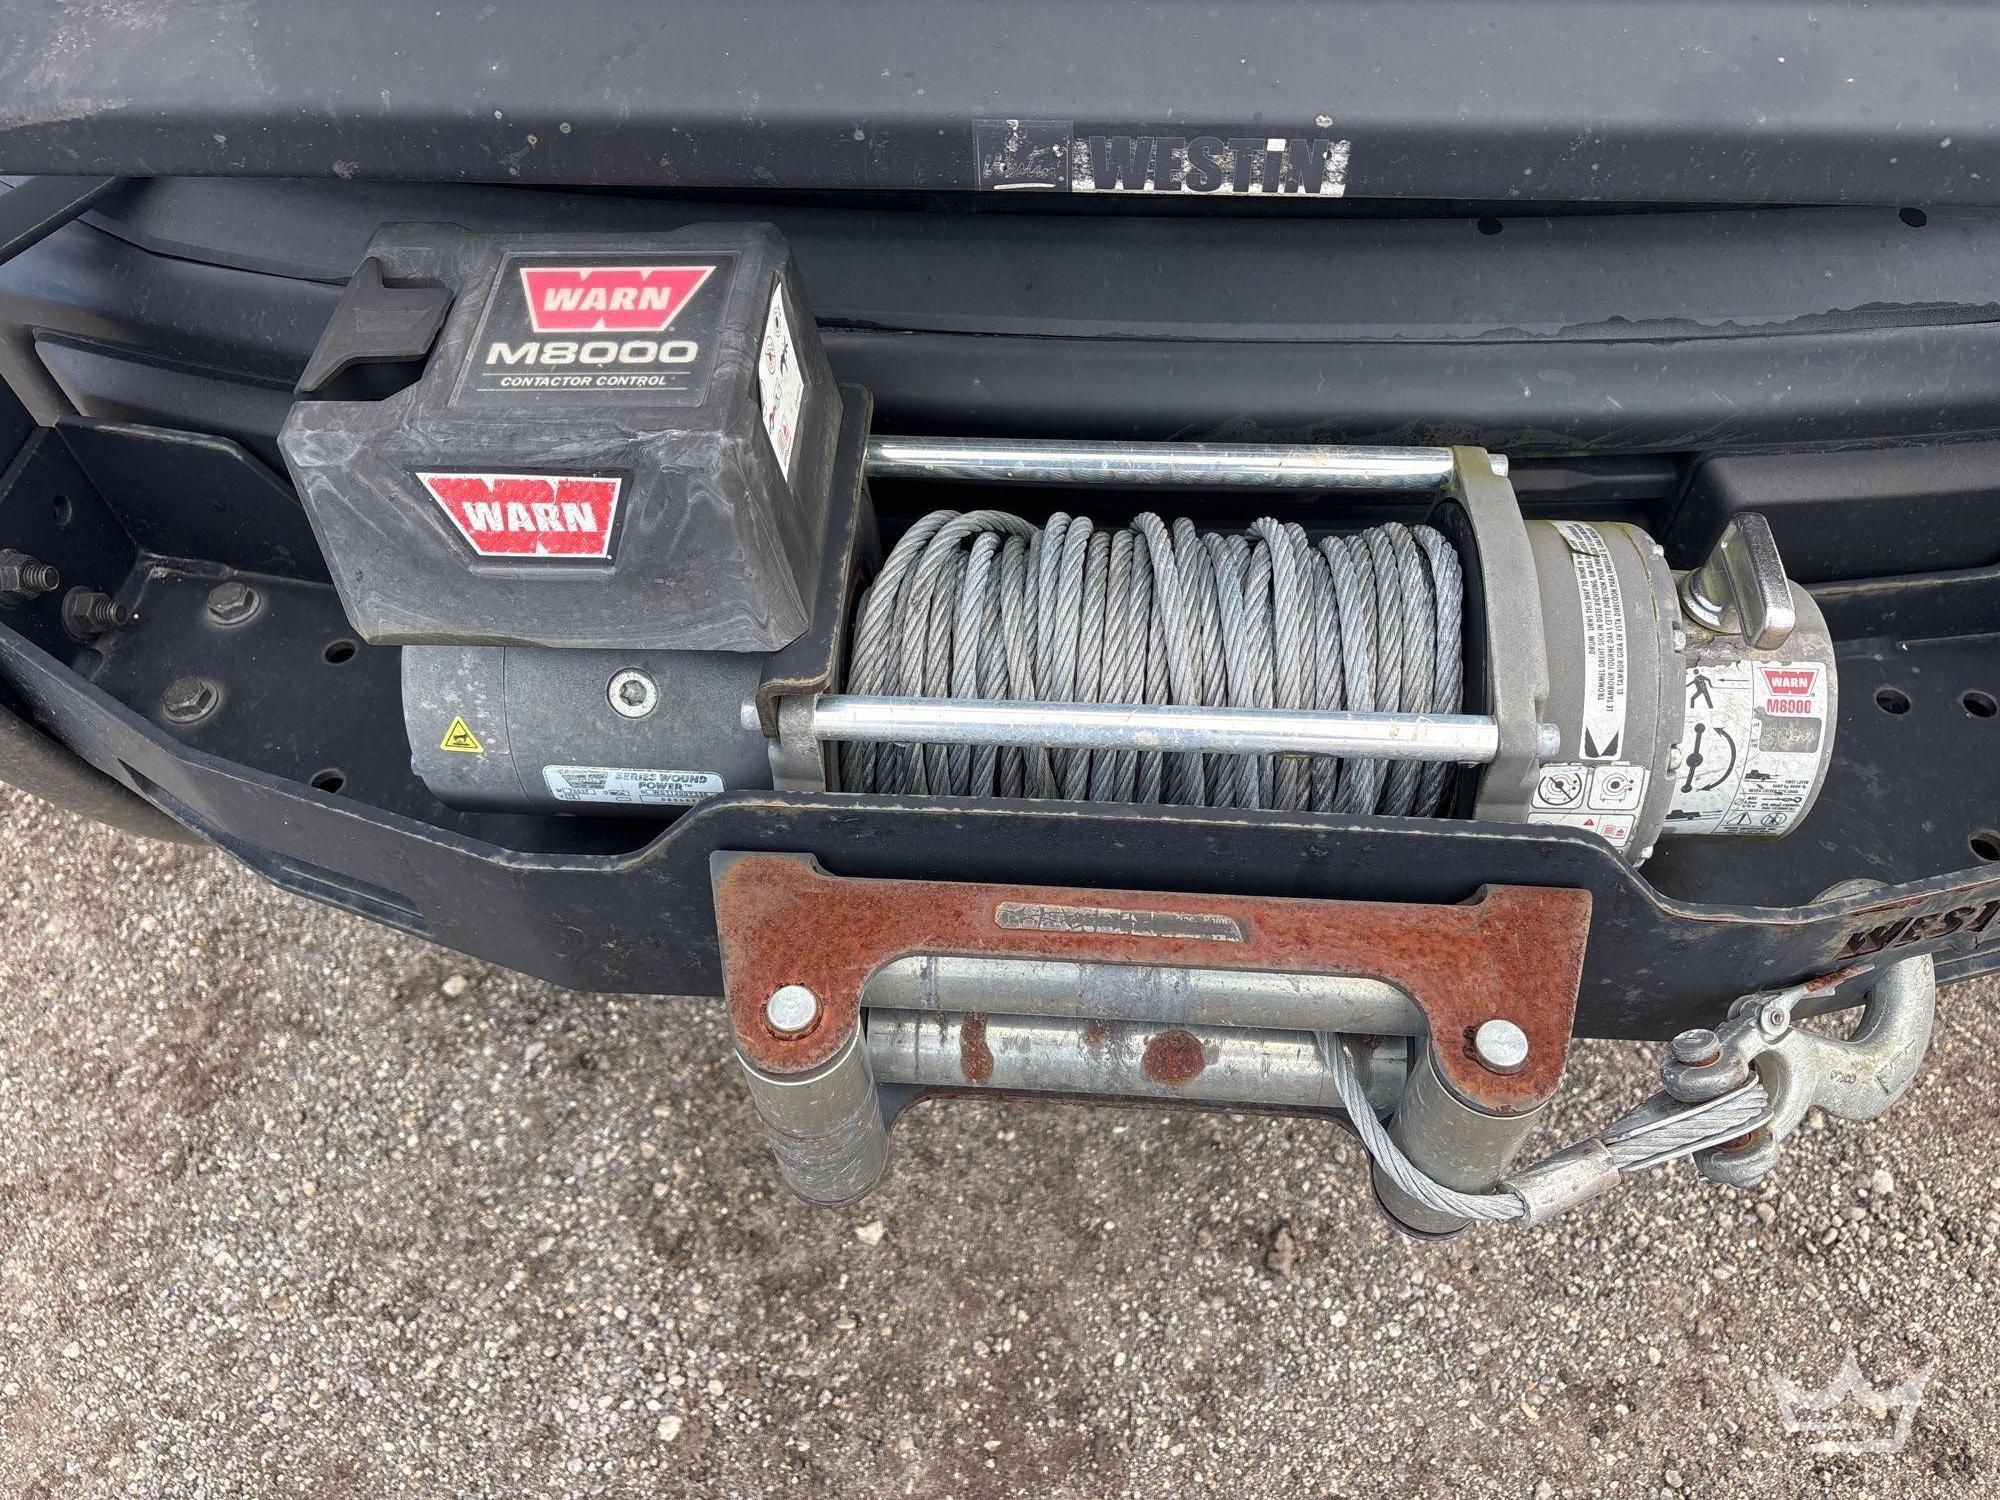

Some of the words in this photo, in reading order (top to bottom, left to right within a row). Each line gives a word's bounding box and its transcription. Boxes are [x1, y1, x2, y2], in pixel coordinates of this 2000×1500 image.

[543, 287, 672, 311] WARN
[486, 340, 698, 365] M8000
[501, 376, 592, 387] CONTACTOR
[596, 375, 668, 387] CONTROL
[461, 501, 598, 533] WARN
[1585, 602, 1593, 613] THIS
[1588, 636, 1596, 655] DRUM
[1597, 648, 1606, 667] DREHT
[1607, 645, 1615, 670] TOURNE
[1597, 670, 1606, 700] TROMMEL
[1607, 672, 1615, 703] TAMBOUR
[1771, 677, 1808, 688] WARN
[1766, 699, 1812, 714] M8000
[660, 774, 708, 784] WOUND
